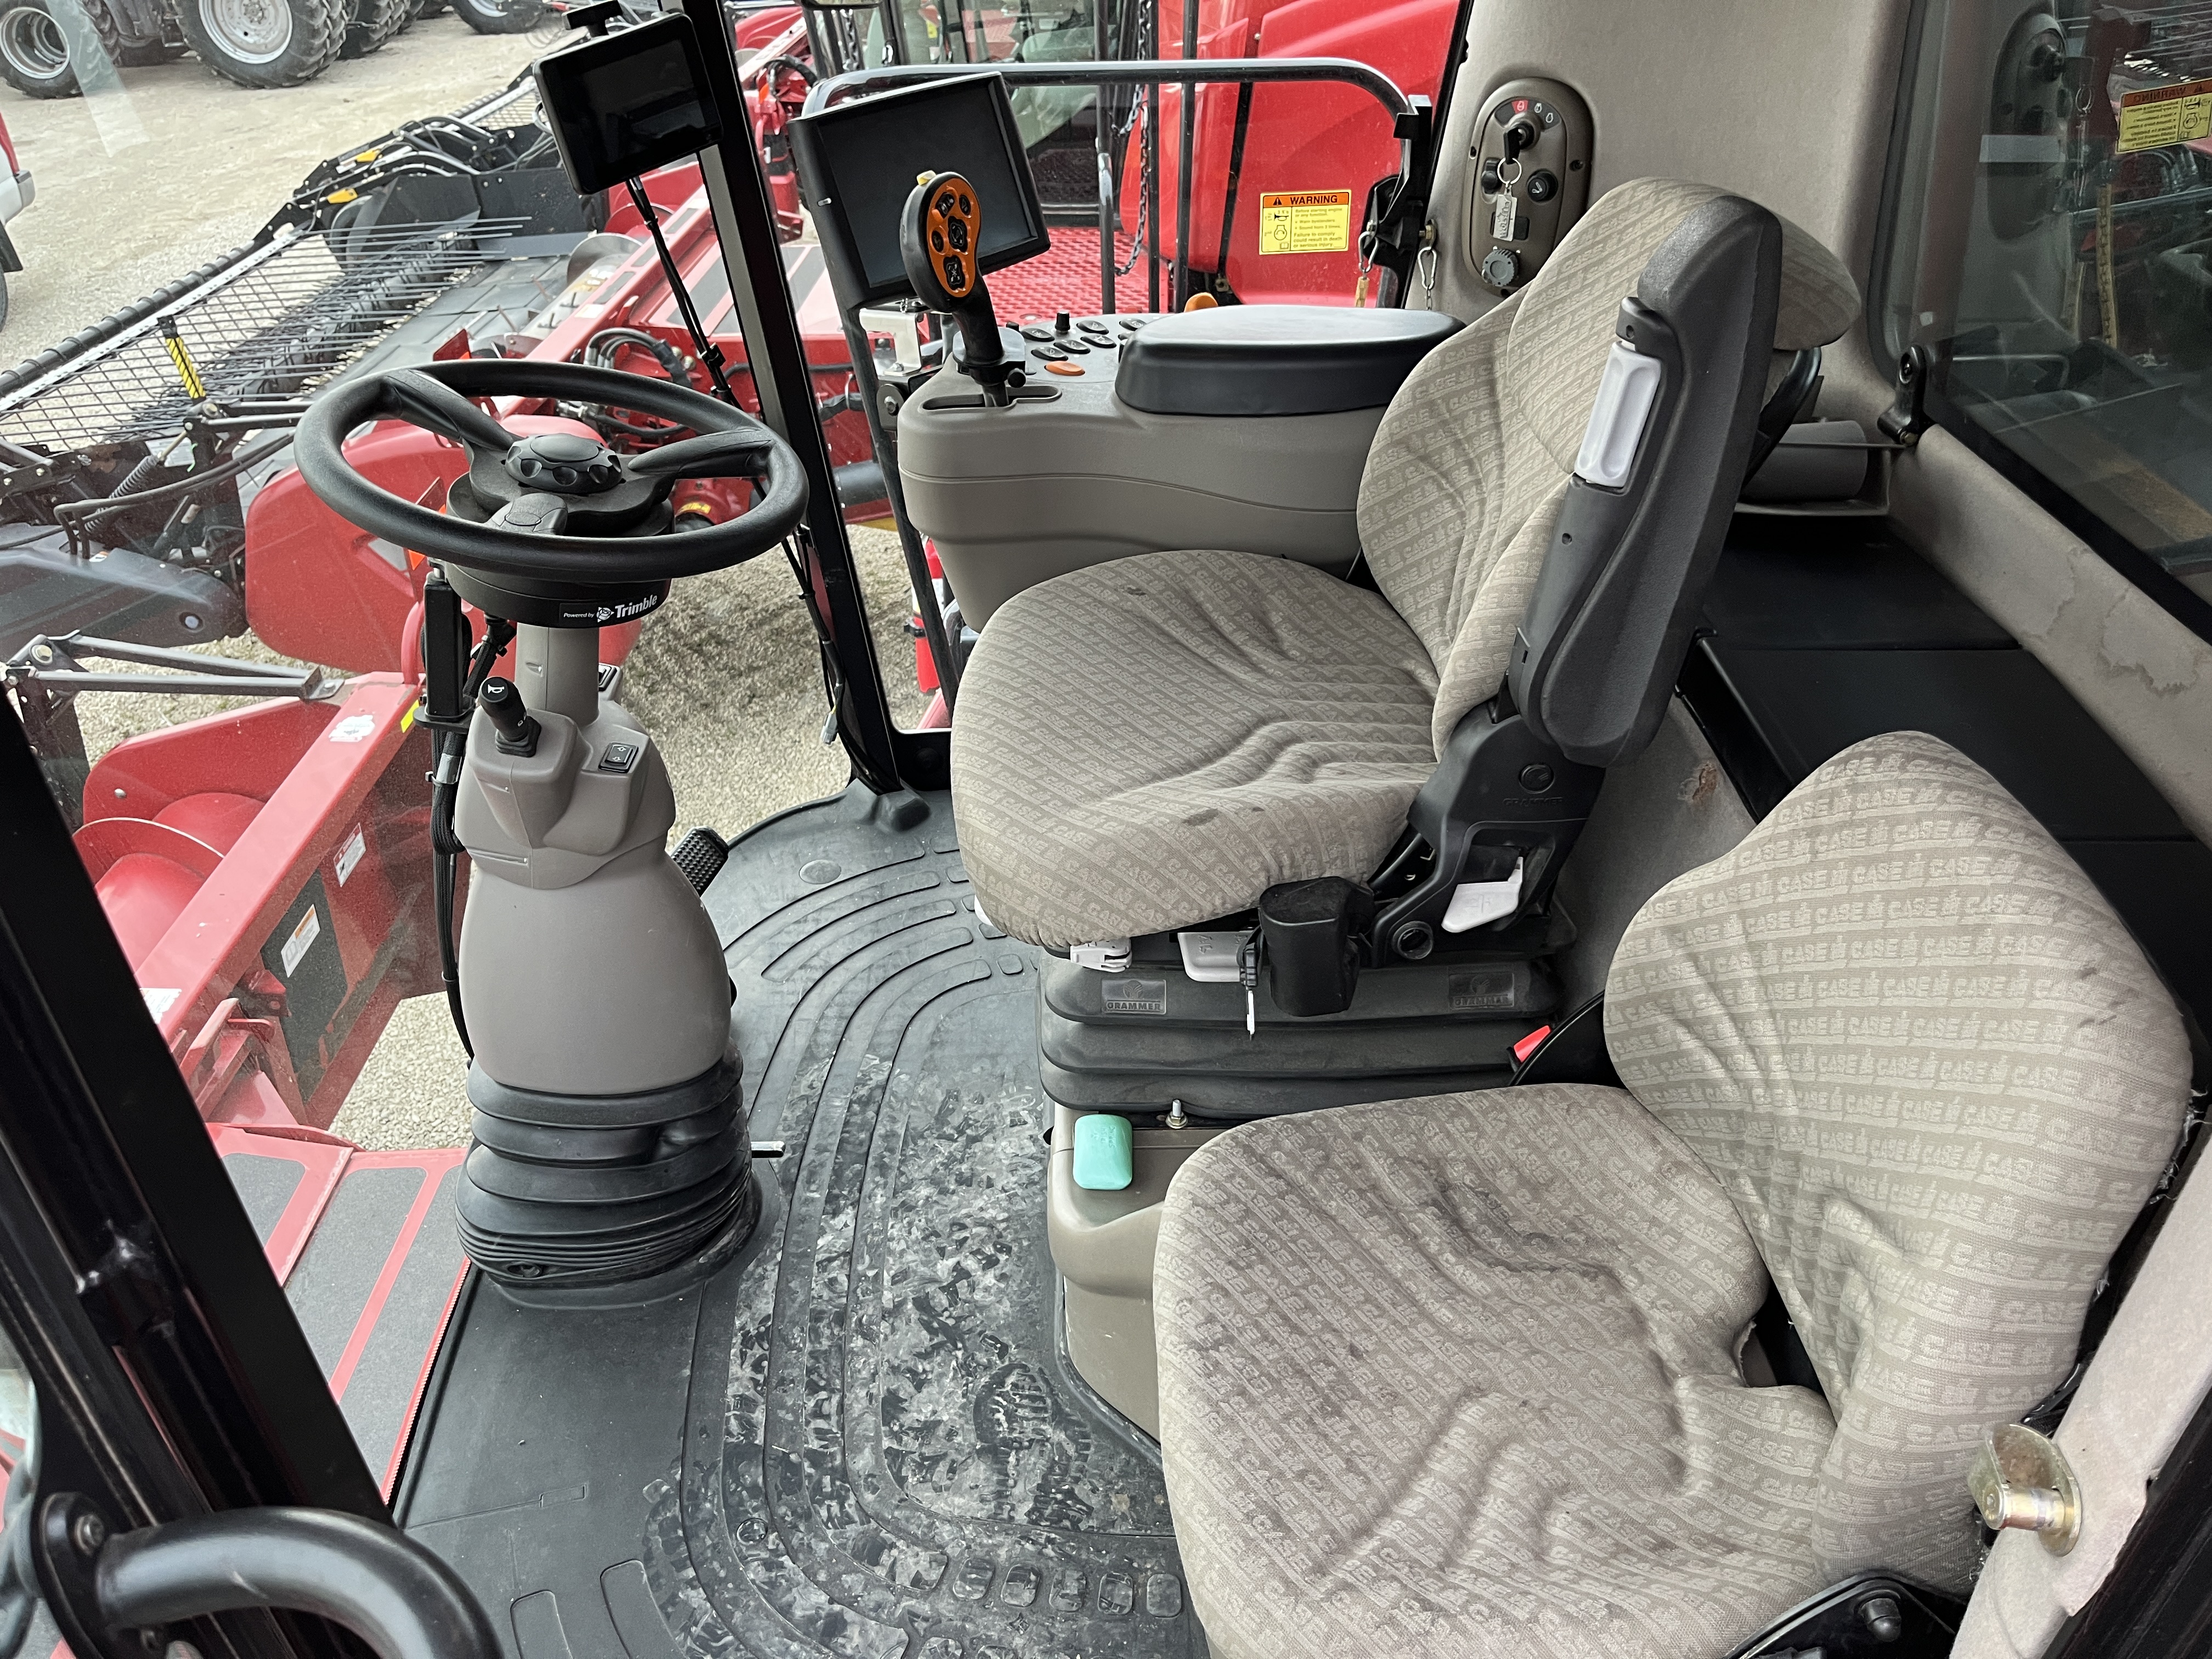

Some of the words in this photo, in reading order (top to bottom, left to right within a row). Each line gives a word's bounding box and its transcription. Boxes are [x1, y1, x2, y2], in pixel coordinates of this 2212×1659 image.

[1290, 195, 1338, 205] WARNING
[1449, 385, 1491, 409] CASE
[1371, 524, 1406, 549] CASE
[1403, 533, 1434, 558] CASE
[1386, 567, 1419, 591] CASE
[1415, 579, 1444, 602] CASE
[614, 594, 658, 618] Trimble
[994, 747, 1034, 769] CASE
[998, 771, 1039, 794] CASE
[960, 776, 991, 795] CASE
[1002, 799, 1042, 822] CASE
[1053, 826, 1097, 850] CASE
[1779, 799, 1830, 823] CASE
[1857, 788, 1915, 810] CASE
[1815, 828, 1867, 852] CASE
[1892, 821, 1950, 843] CASE
[1702, 883, 1752, 909] CASE
[1776, 870, 1827, 893] CASE
[1815, 902, 1864, 925] CASE
[1887, 896, 1939, 919] CASE
[1781, 943, 1828, 964] CASE
[1850, 939, 1899, 959] CASE
[1922, 936, 1973, 957] CASE
[1816, 977, 1862, 999] CASE
[1787, 1016, 1828, 1035] CASE
[1848, 1015, 1892, 1037] CASE
[1912, 1018, 1961, 1039] CASE
[1983, 1019, 2040, 1042] CASE
[1818, 1053, 1859, 1074] CASE
[1877, 1056, 1920, 1077] CASE
[1939, 1060, 1990, 1082] CASE
[1845, 1094, 1884, 1118] CASE
[1900, 1098, 1945, 1122] CASE
[1820, 1131, 1855, 1152] CASE
[1870, 1138, 1908, 1161] CASE
[1233, 1176, 1280, 1219] CASE
